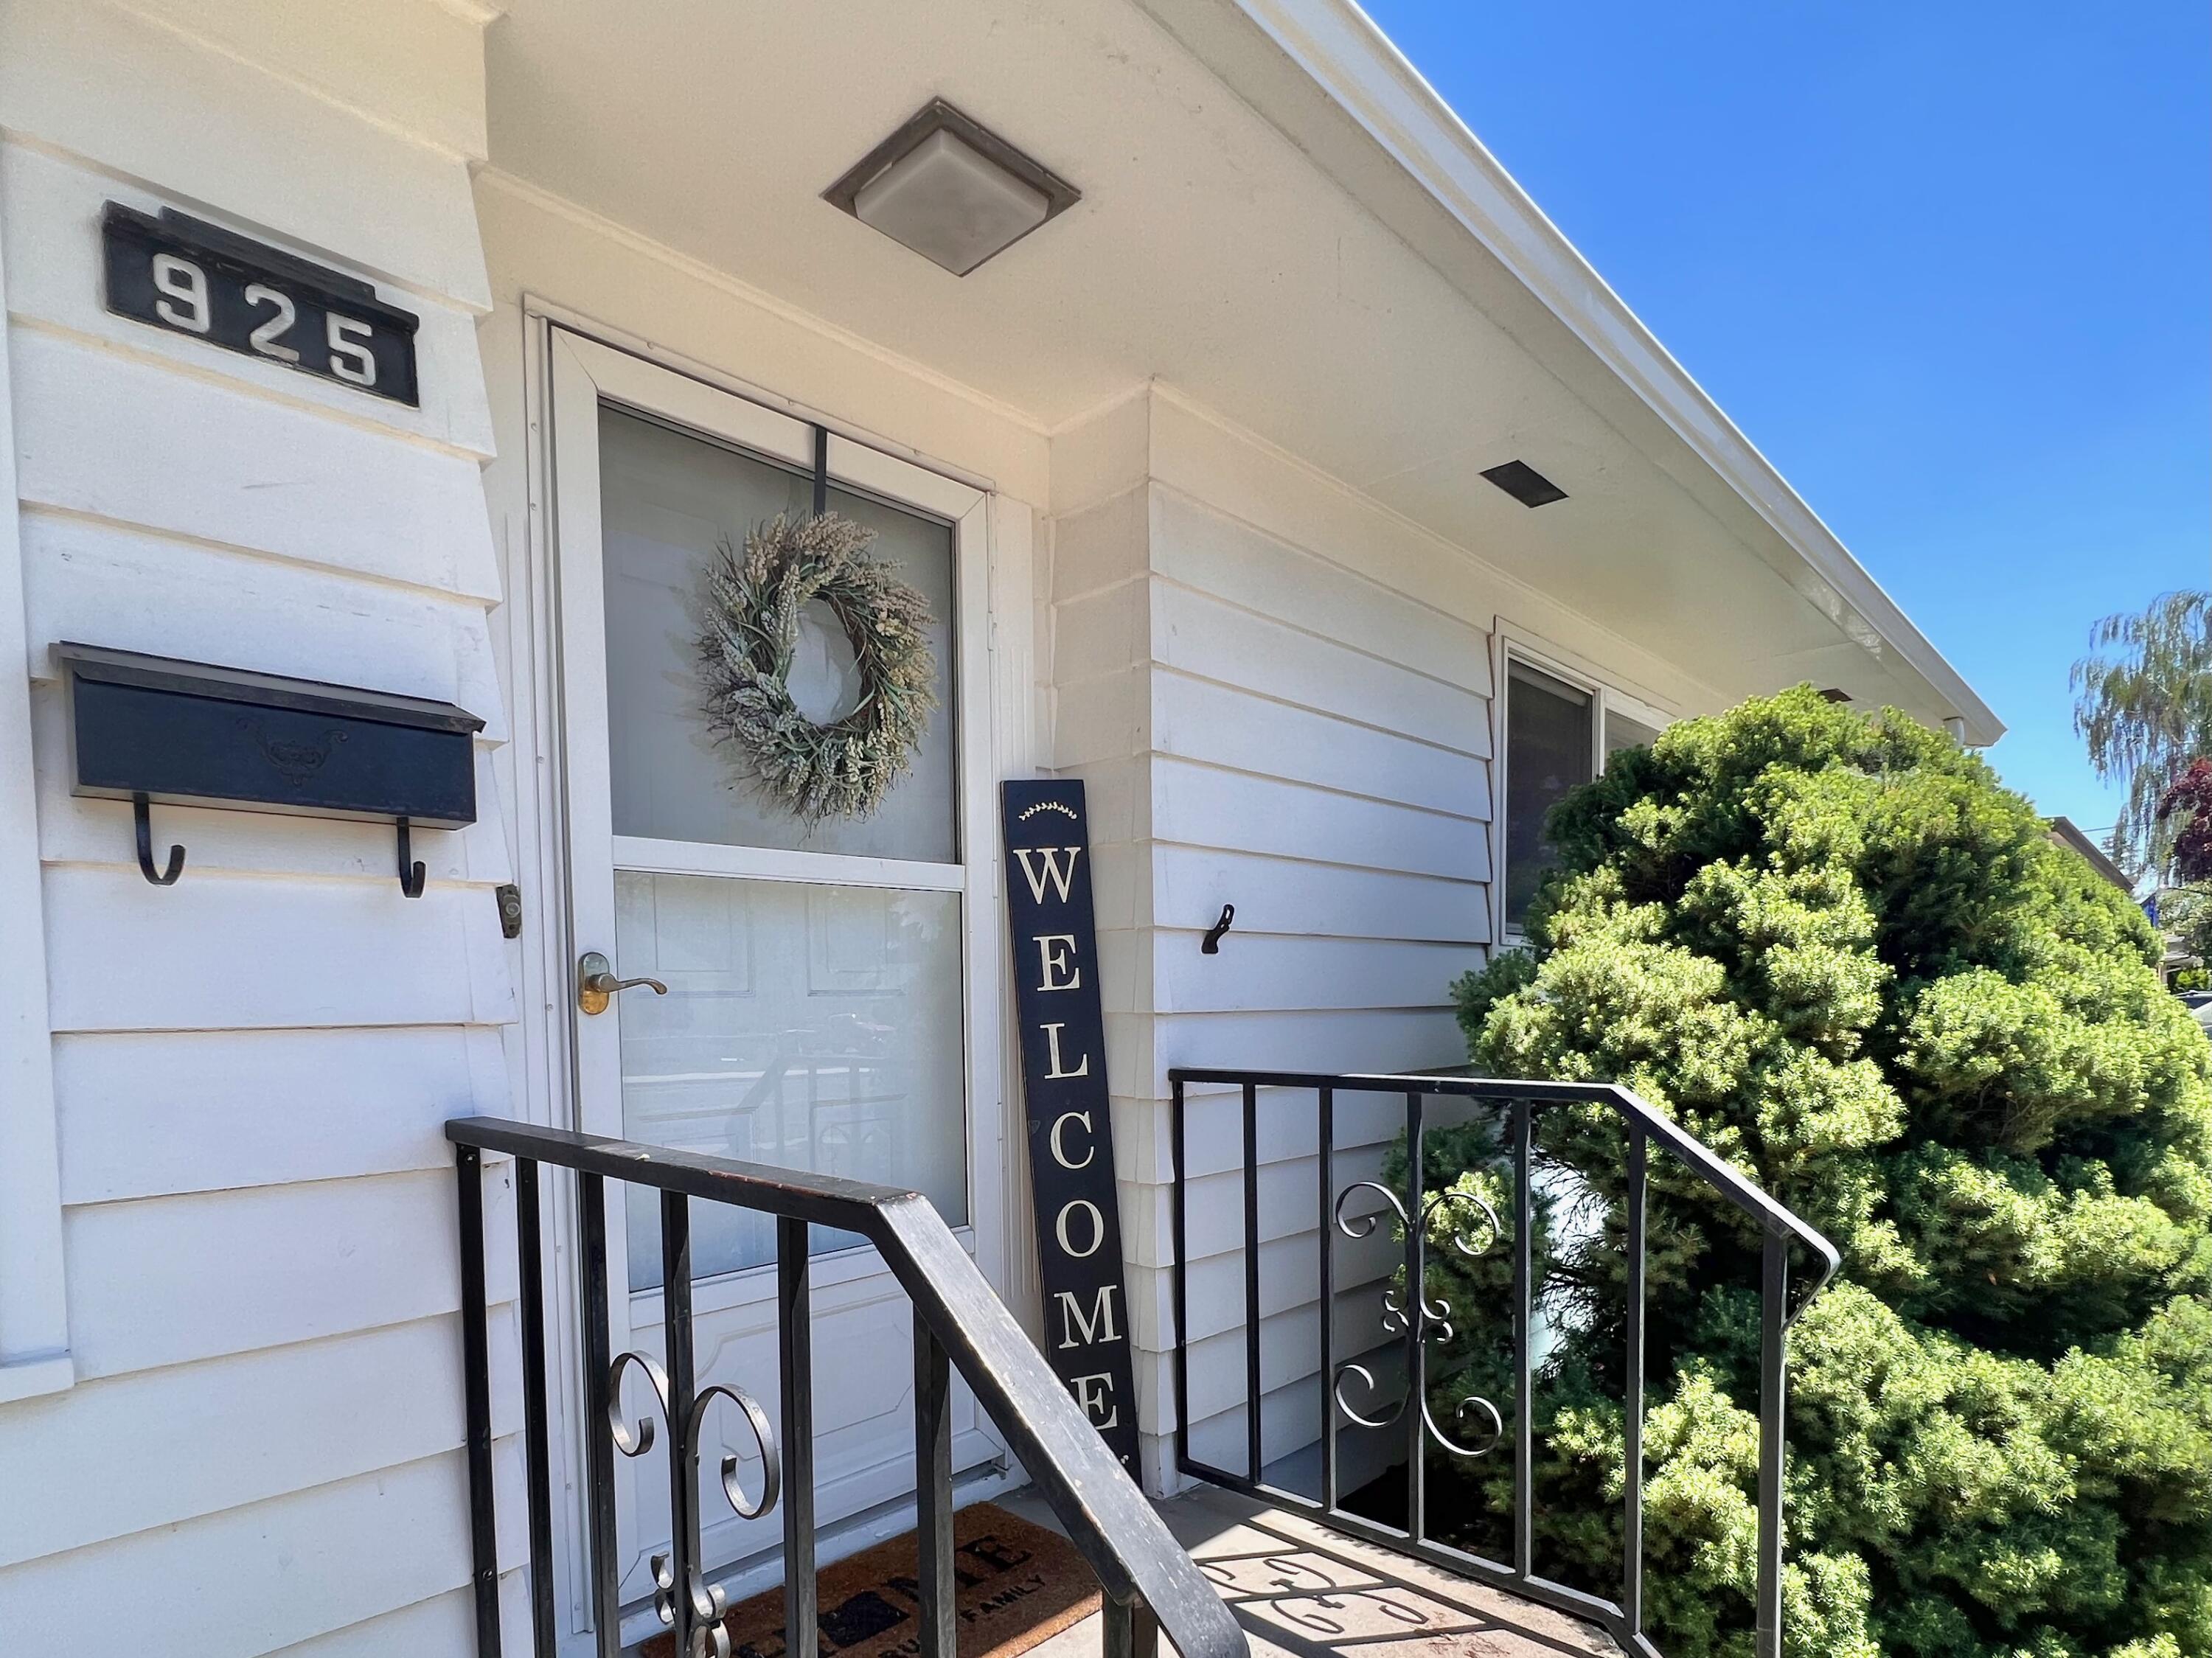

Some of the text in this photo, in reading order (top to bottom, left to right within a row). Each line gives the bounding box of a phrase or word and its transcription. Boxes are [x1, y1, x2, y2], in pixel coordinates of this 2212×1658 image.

[152, 252, 377, 386] 925
[1013, 846, 1121, 1431] WELCOME
[959, 1574, 1047, 1623] FAMILY
